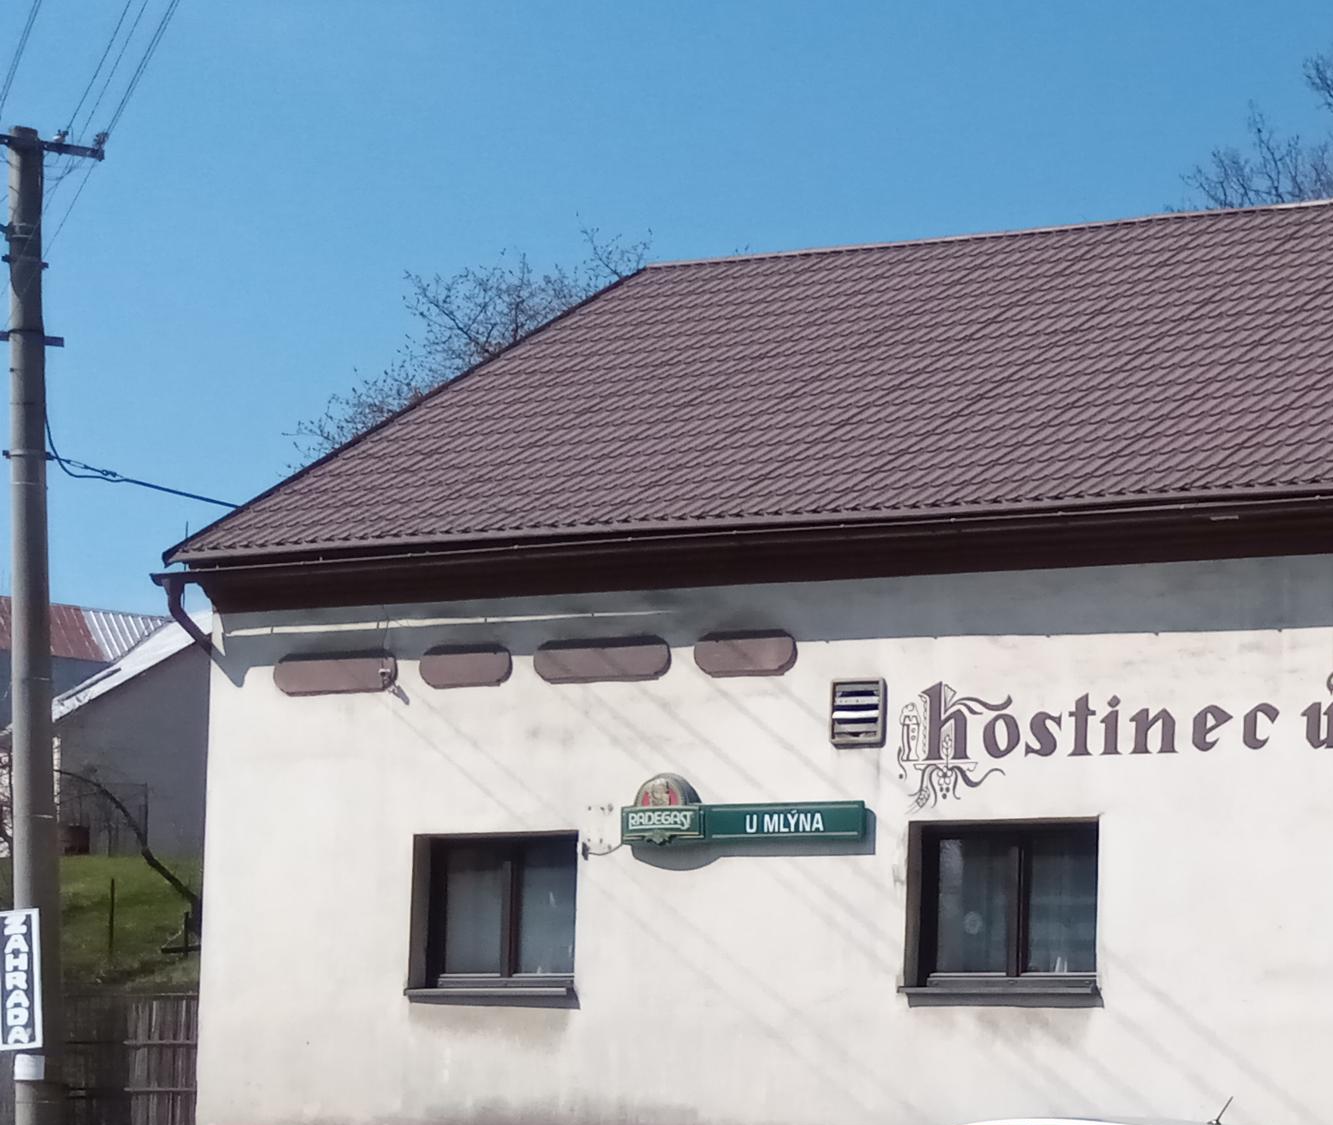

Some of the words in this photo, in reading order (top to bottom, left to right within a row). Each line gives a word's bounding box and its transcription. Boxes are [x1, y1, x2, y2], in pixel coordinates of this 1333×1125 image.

[628, 810, 695, 831] RADEGAST
[745, 814, 757, 834] U
[763, 810, 824, 833] MLÝNA
[4, 913, 30, 1045] ZAHRADA
